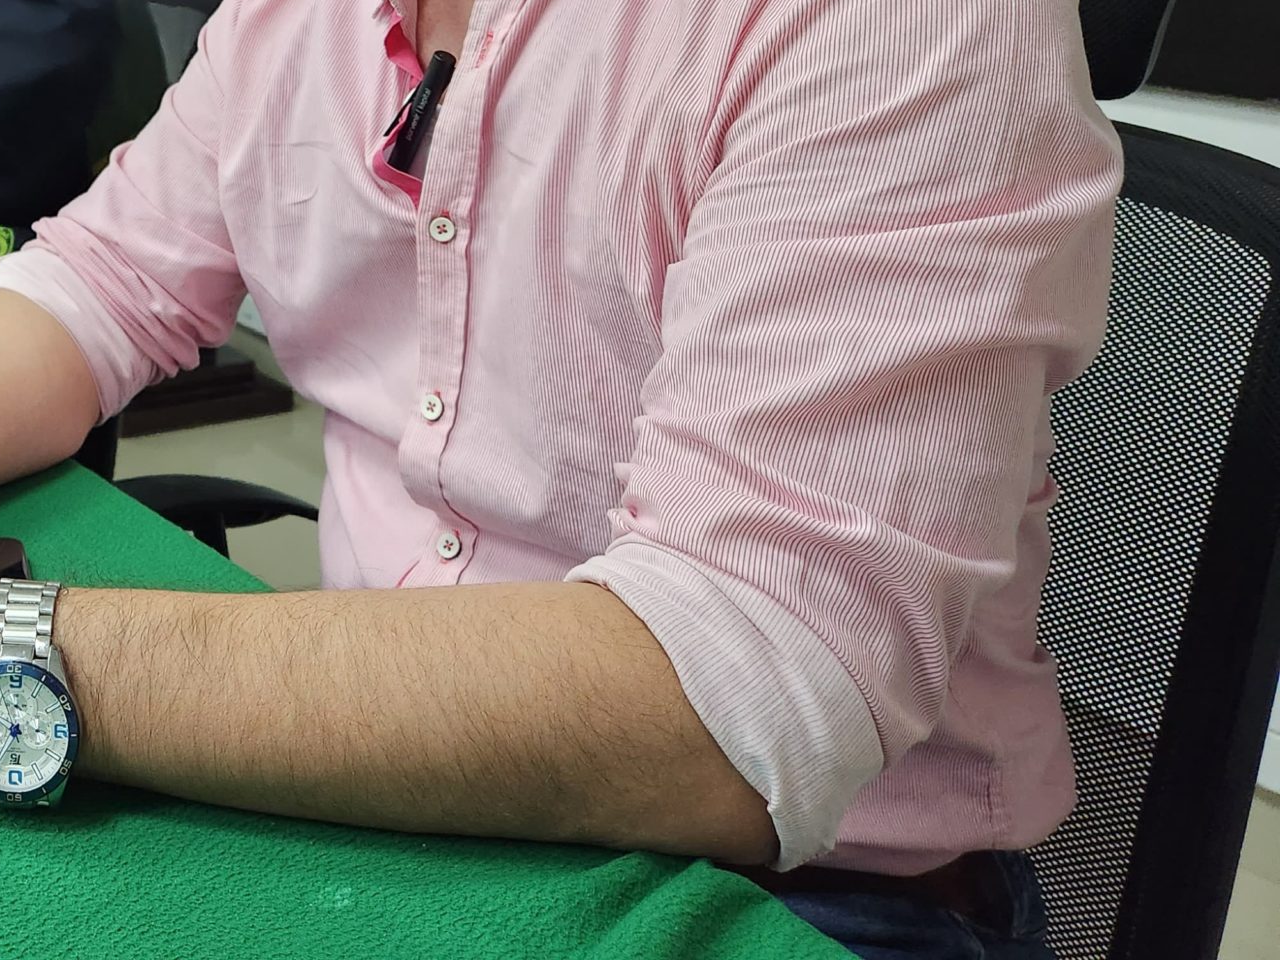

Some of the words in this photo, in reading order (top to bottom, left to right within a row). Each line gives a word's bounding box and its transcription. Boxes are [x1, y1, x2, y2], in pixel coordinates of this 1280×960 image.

[6, 664, 22, 673] 30
[9, 674, 23, 689] 6
[59, 694, 72, 711] 40
[60, 759, 72, 776] 50
[6, 793, 22, 802] 60
